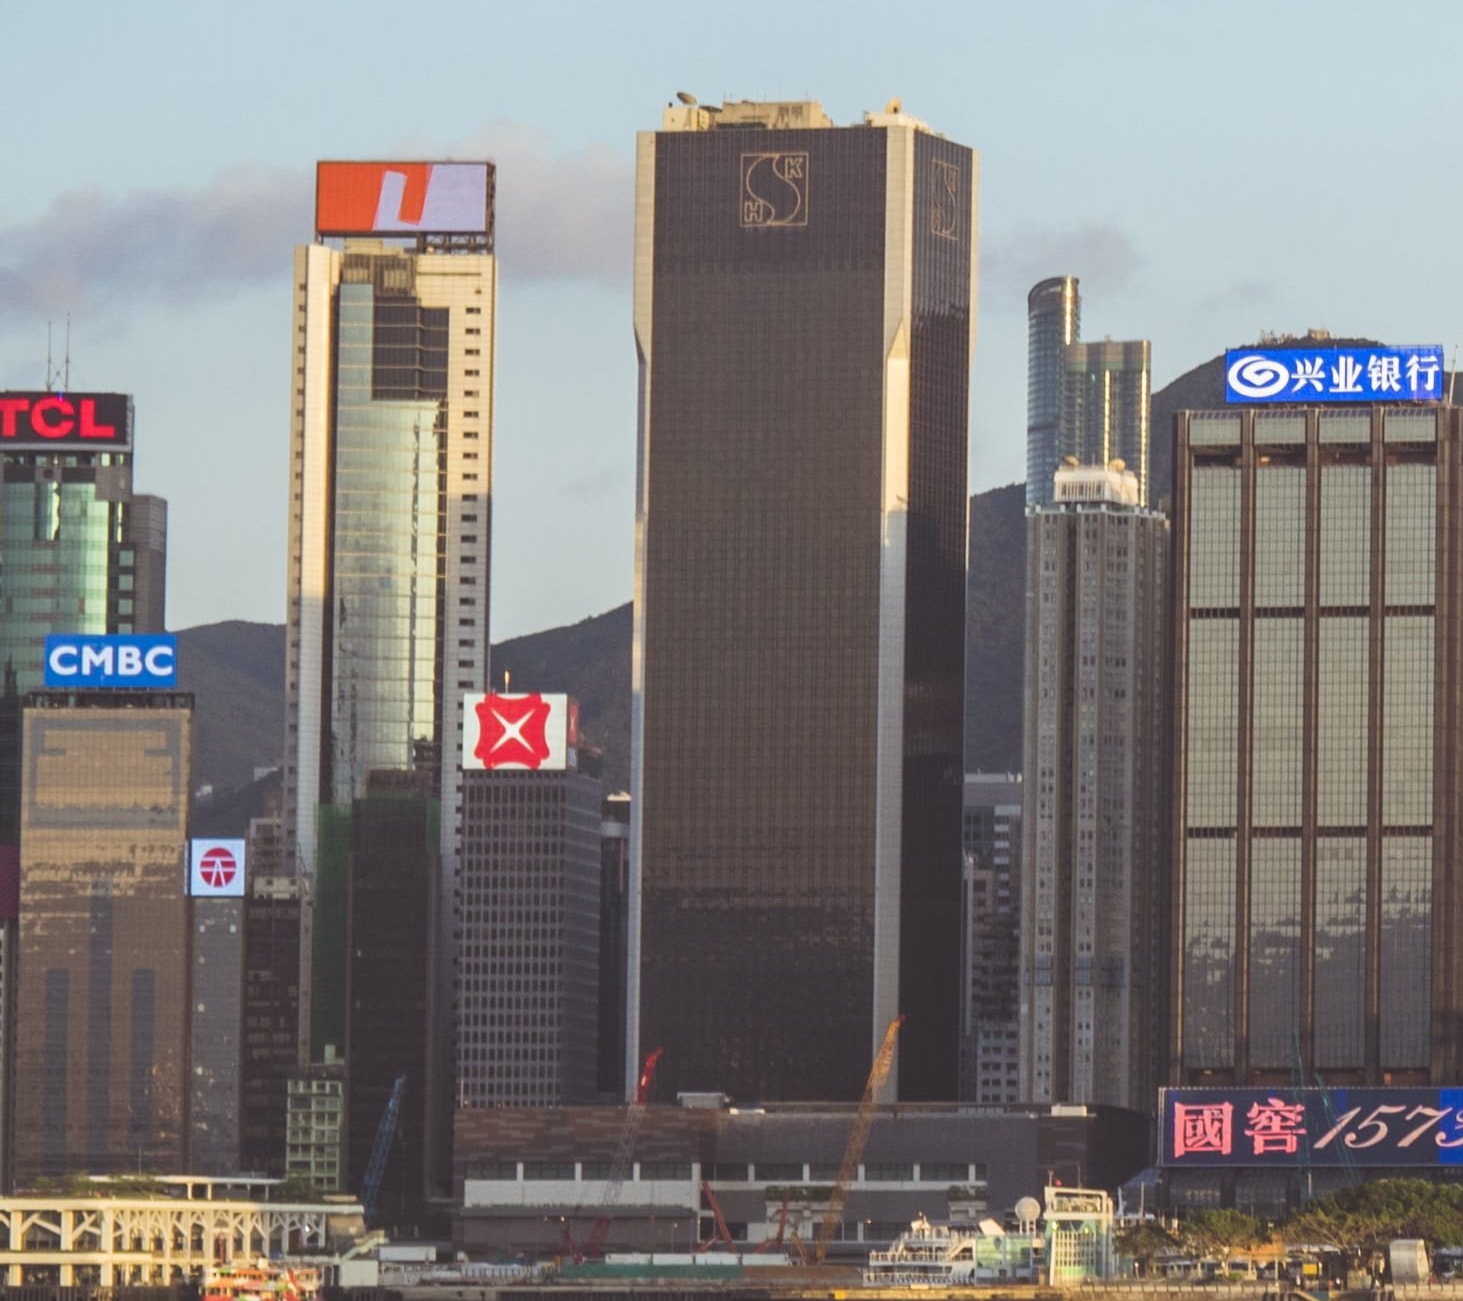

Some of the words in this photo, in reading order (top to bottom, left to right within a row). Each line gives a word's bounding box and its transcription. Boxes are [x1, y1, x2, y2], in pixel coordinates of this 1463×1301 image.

[1291, 354, 1440, 393] 兴业银行
[0, 397, 115, 438] TCL
[49, 645, 173, 676] CMBC
